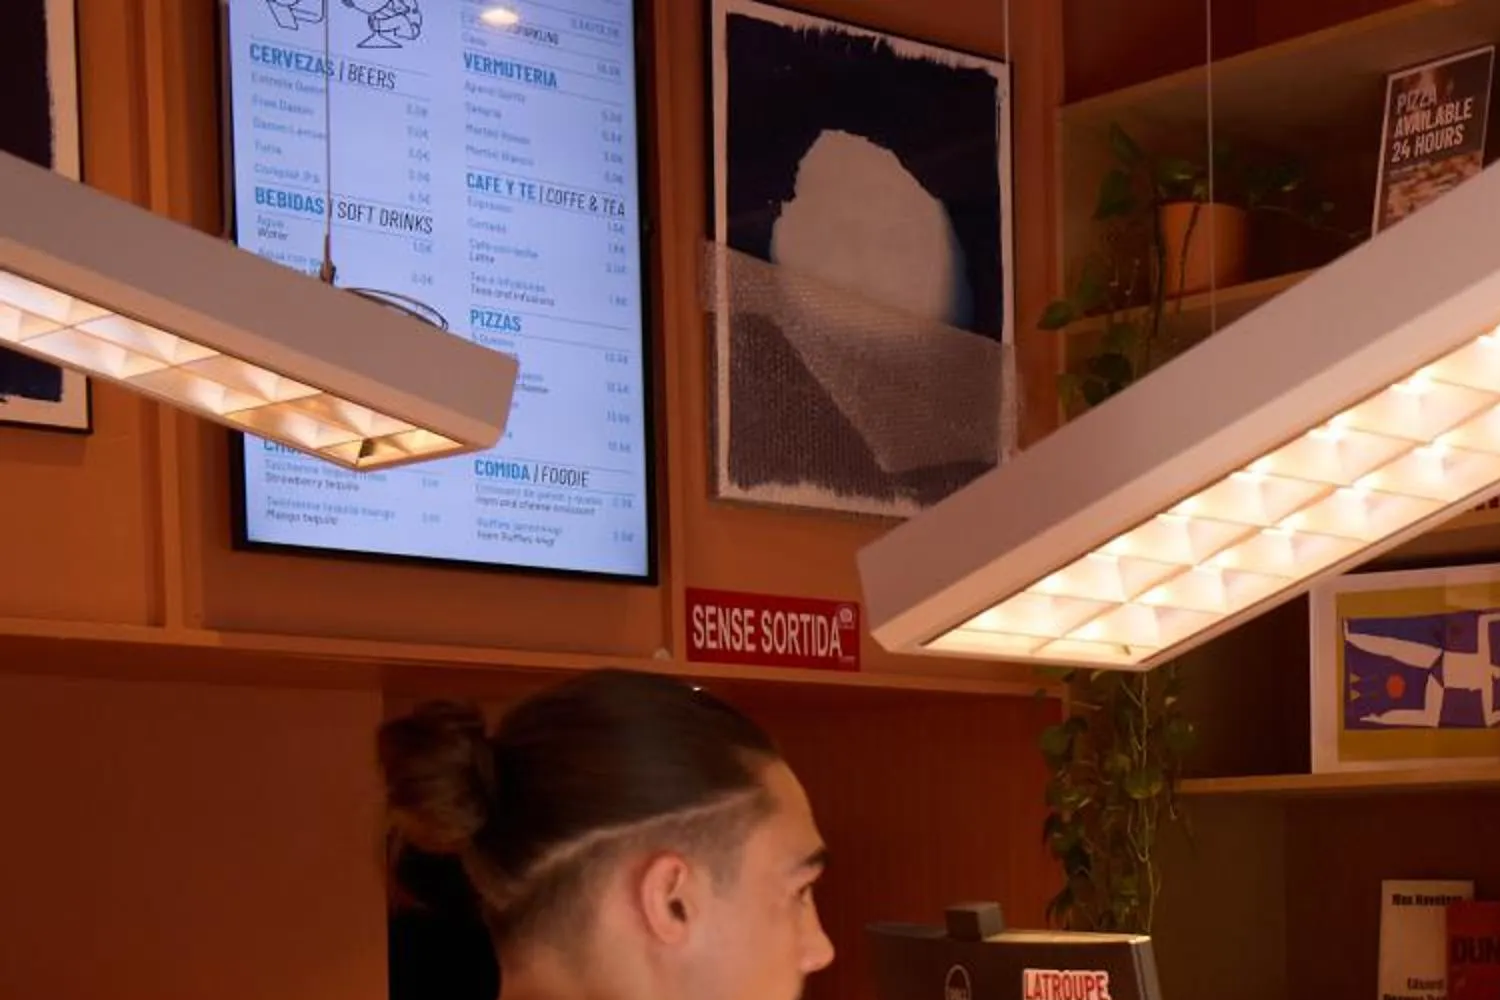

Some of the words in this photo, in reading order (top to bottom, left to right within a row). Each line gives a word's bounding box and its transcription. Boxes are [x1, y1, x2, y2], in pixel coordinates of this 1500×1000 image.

[249, 42, 335, 77] CERVEZAS
[347, 62, 396, 90] BEERS
[463, 52, 558, 90] VERMUTERIA
[1394, 97, 1473, 138] AVAILABLE
[1397, 86, 1437, 113] PIZZA
[1391, 139, 1411, 163] 24
[1414, 124, 1465, 157] HOURS
[254, 186, 325, 216] BEBIDAS
[337, 203, 375, 226] SOFT
[379, 209, 434, 236] DRINKS
[466, 172, 502, 194] CAFE
[504, 178, 515, 196] Y
[519, 182, 537, 201] TE
[545, 187, 585, 209] COFFE
[588, 194, 598, 212] &
[602, 197, 626, 217] TEA
[470, 309, 521, 333] PIZZAS
[474, 459, 530, 482] COMIDA
[541, 464, 590, 488] FOODIE
[692, 604, 756, 652] SENSE
[761, 611, 842, 657] SORTIDA
